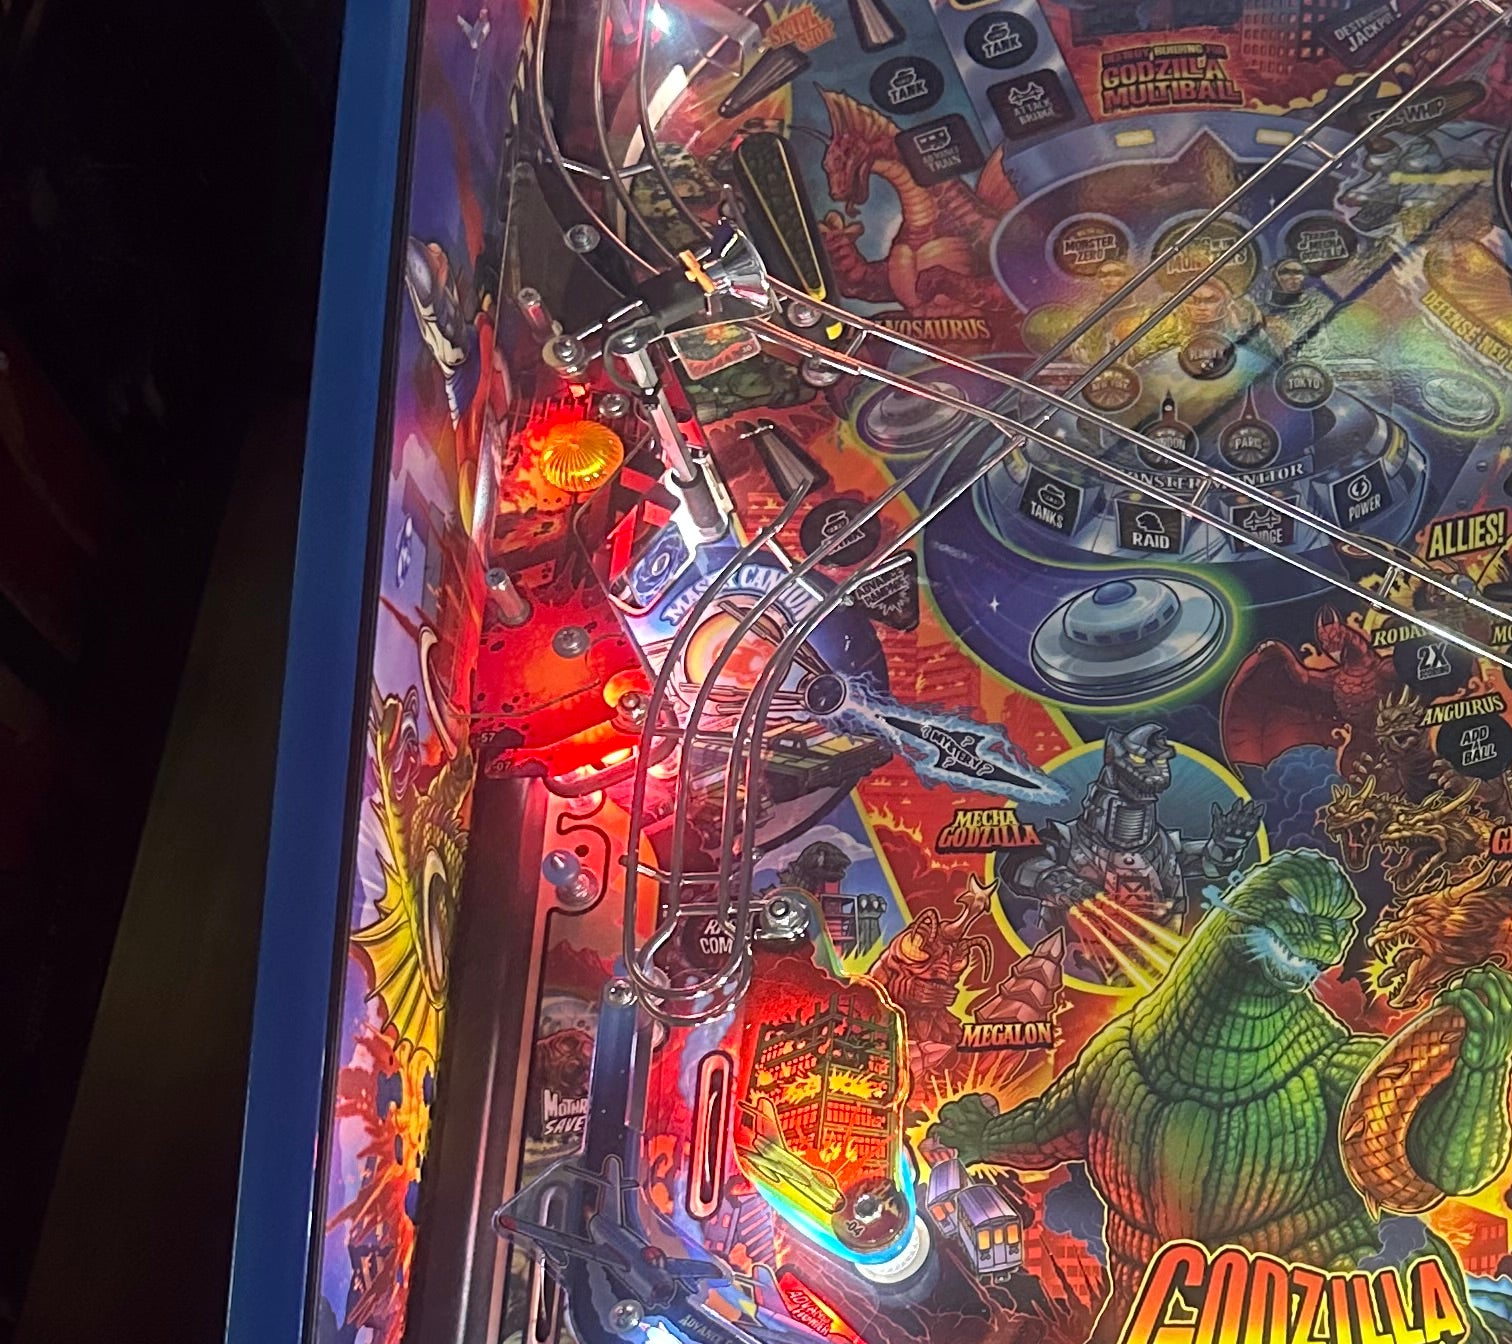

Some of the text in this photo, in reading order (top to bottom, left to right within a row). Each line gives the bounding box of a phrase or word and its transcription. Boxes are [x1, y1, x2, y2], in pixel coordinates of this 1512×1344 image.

[800, 21, 834, 49] SHOT
[982, 34, 1023, 58] TANK
[1102, 57, 1228, 89] GODZILLA
[888, 80, 929, 105] TANK
[1102, 80, 1243, 113] MULTIBALL
[1063, 234, 1117, 254] MONSTER
[1421, 289, 1482, 344] DEFENSE
[1287, 377, 1321, 391] TOKYO
[1030, 501, 1064, 530] TANKS
[1348, 493, 1382, 522] POWER
[1131, 532, 1171, 550] RAID
[1429, 511, 1506, 559] ALLIES!
[1373, 621, 1433, 646] RODA
[1417, 643, 1448, 670] 2X
[1421, 695, 1504, 726] ANGUIRUS
[1460, 725, 1490, 747] ADD
[930, 732, 982, 774] MYSTERY
[1461, 744, 1498, 766] BALL
[954, 809, 1019, 829] MECHA
[938, 824, 1041, 849] GODZILLA
[962, 1022, 1052, 1047] MEGALON
[543, 1089, 589, 1117] MOTHR
[543, 1117, 586, 1136] SAVE
